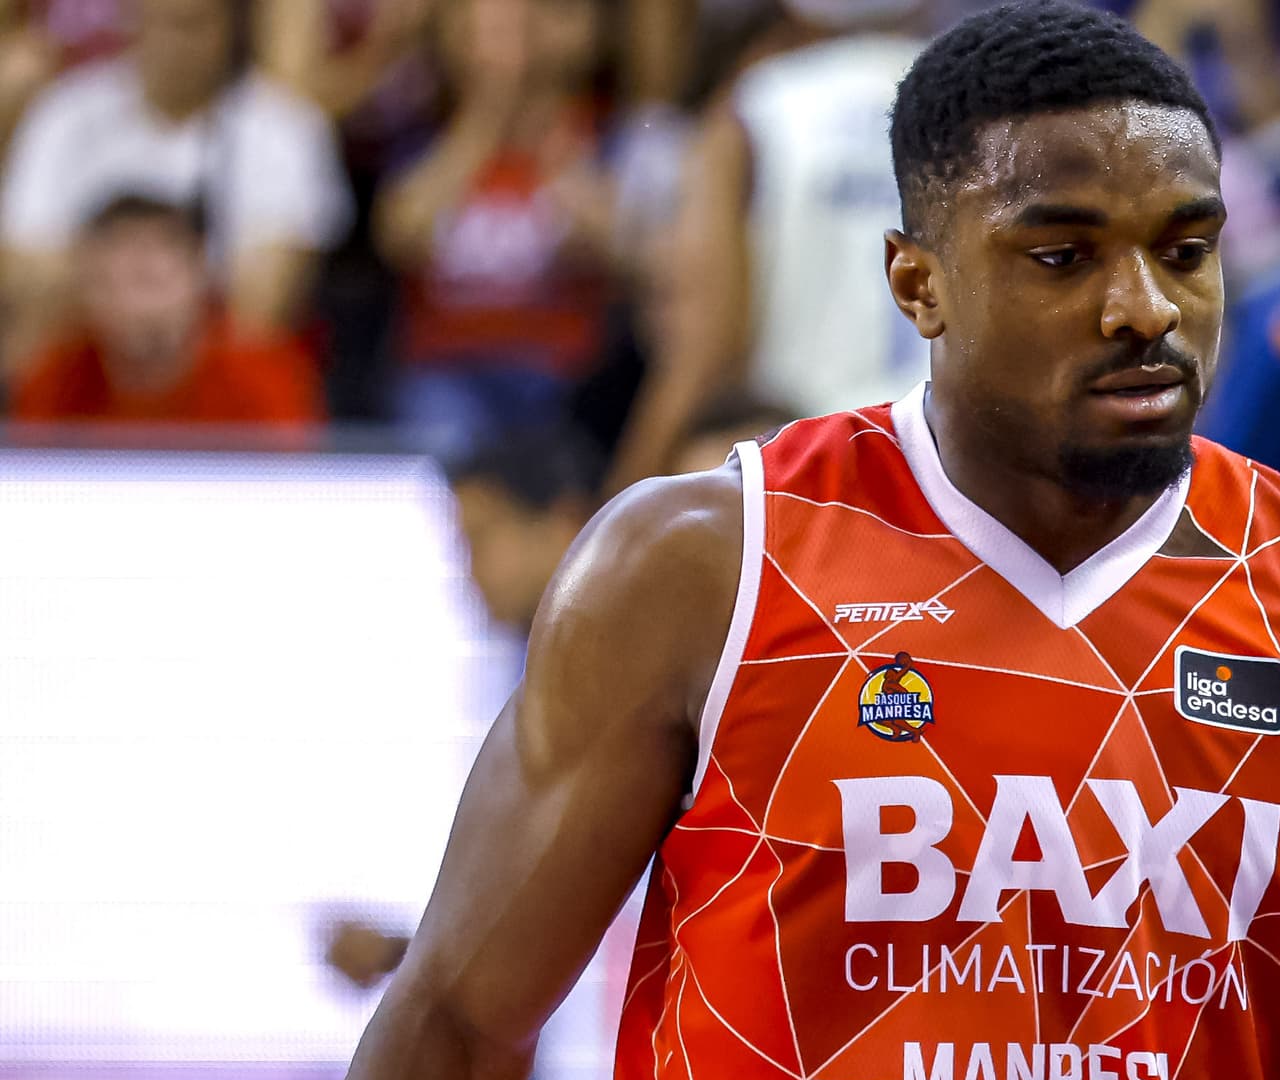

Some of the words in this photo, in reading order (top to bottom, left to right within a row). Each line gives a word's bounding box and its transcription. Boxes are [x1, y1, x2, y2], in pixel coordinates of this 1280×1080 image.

[1186, 671, 1228, 697] liga
[861, 704, 932, 723] MANRESA
[1186, 696, 1278, 724] endesa
[844, 943, 1249, 1011] CLIMATIZACIÓN
